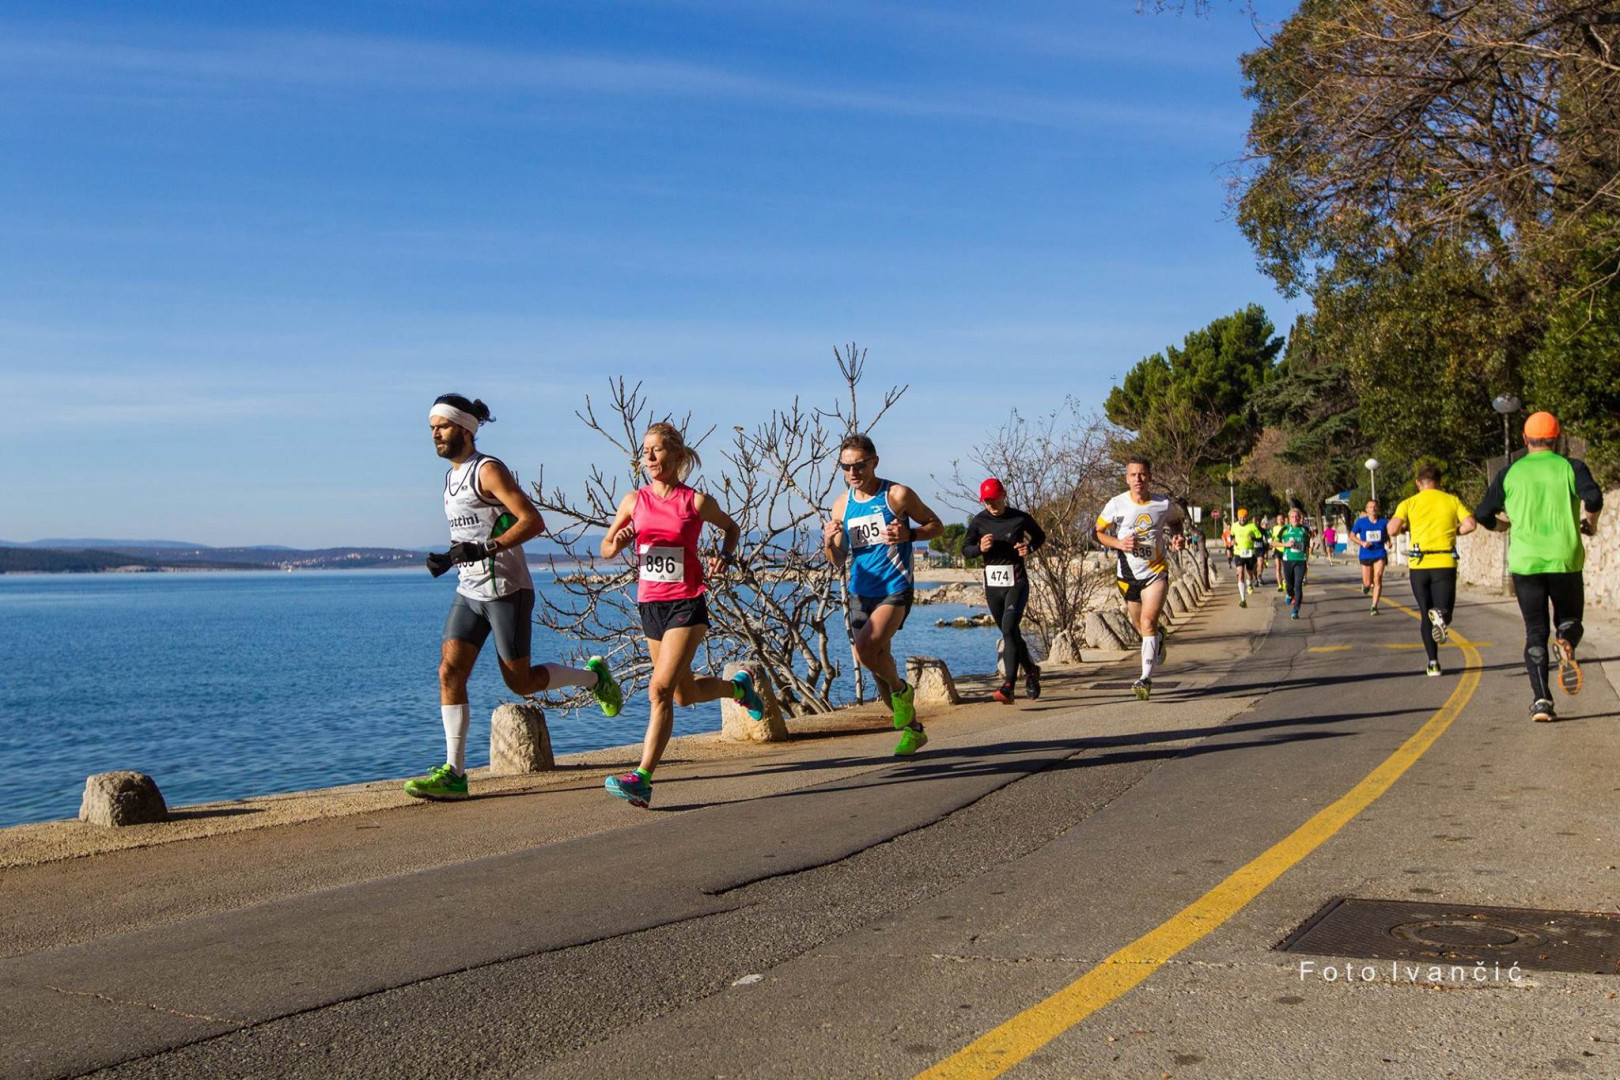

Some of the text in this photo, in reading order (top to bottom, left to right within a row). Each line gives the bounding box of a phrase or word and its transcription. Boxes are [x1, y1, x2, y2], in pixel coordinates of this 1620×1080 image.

[853, 521, 880, 540] 705
[1132, 546, 1152, 558] 636
[646, 555, 675, 573] 896
[990, 570, 1009, 582] 474
